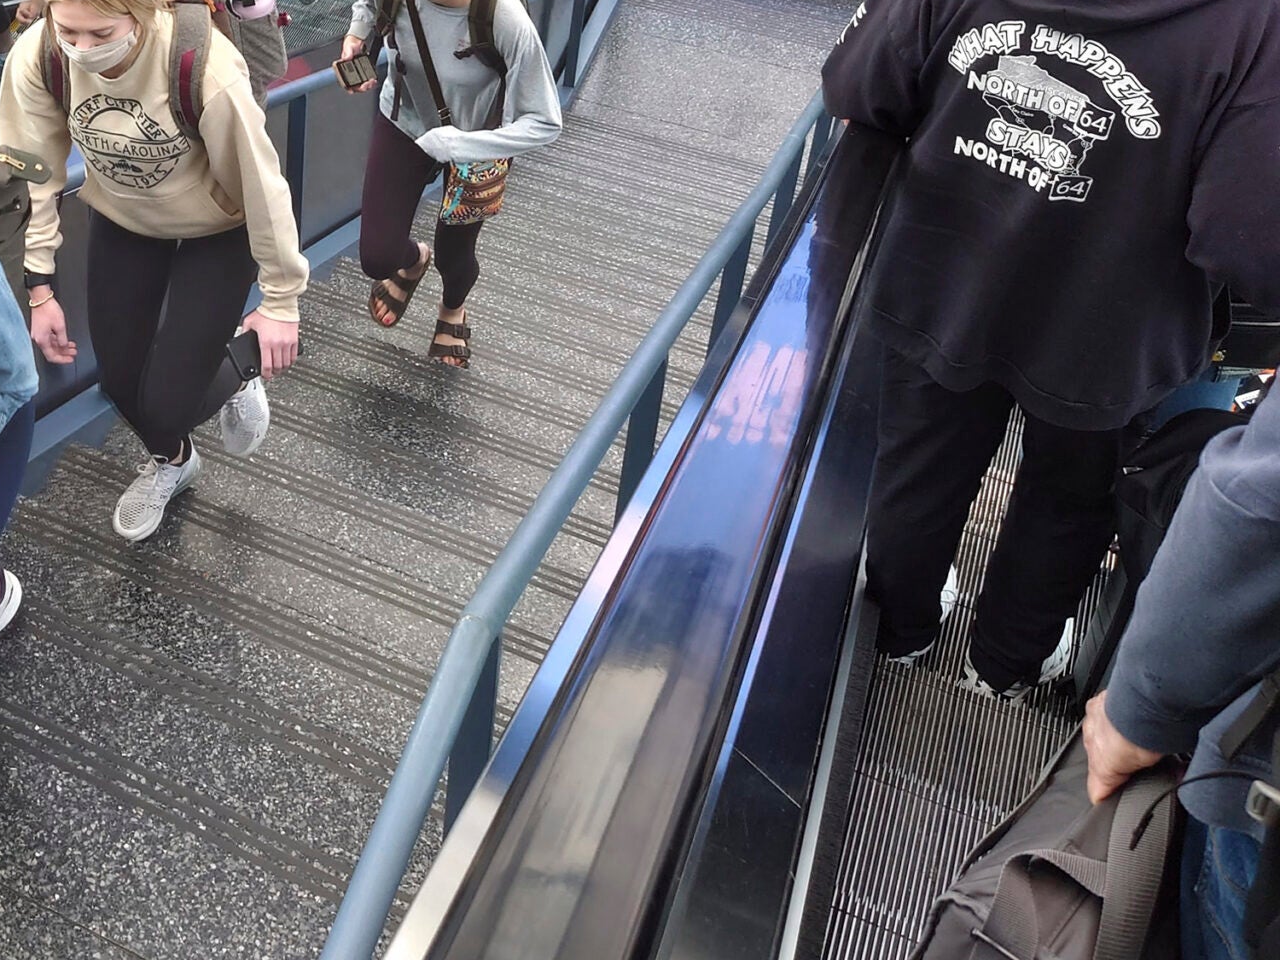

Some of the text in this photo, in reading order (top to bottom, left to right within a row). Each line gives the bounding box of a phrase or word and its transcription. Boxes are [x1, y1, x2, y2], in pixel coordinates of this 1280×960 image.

[948, 21, 1026, 74] WHAT
[1031, 24, 1161, 139] HAPPENS
[967, 71, 1045, 110] NORTH
[1047, 94, 1080, 123] OF
[1079, 111, 1108, 134] 64
[71, 124, 182, 158] NORTH CAROLINA
[76, 97, 163, 139] SURF CITY PIER
[986, 119, 1070, 171] STAYS
[954, 136, 1085, 196] NORTH OF 64
